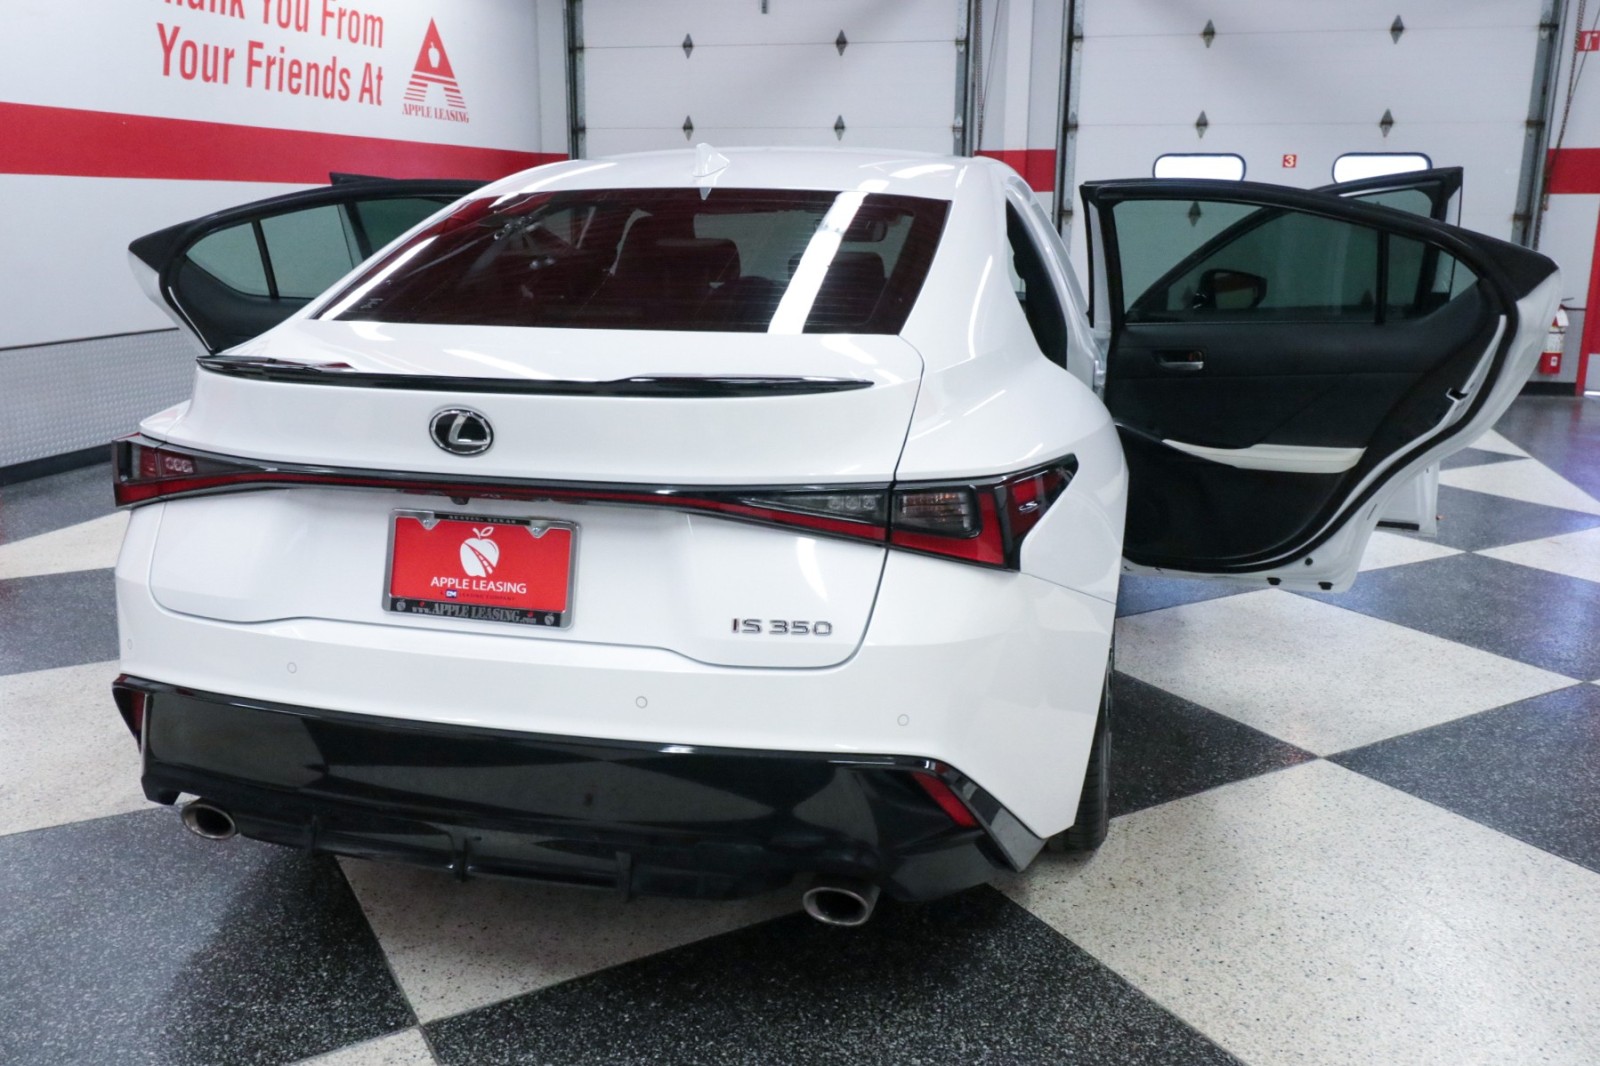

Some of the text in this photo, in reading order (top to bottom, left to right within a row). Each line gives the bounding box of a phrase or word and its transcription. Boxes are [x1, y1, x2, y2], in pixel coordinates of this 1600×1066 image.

[321, 0, 383, 48] From
[157, 22, 383, 106] Your Friends At
[402, 103, 469, 123] APPLE LEASING
[1284, 155, 1295, 167] 3
[431, 576, 527, 594] APPLE LEASING
[731, 618, 832, 635] IS 350
